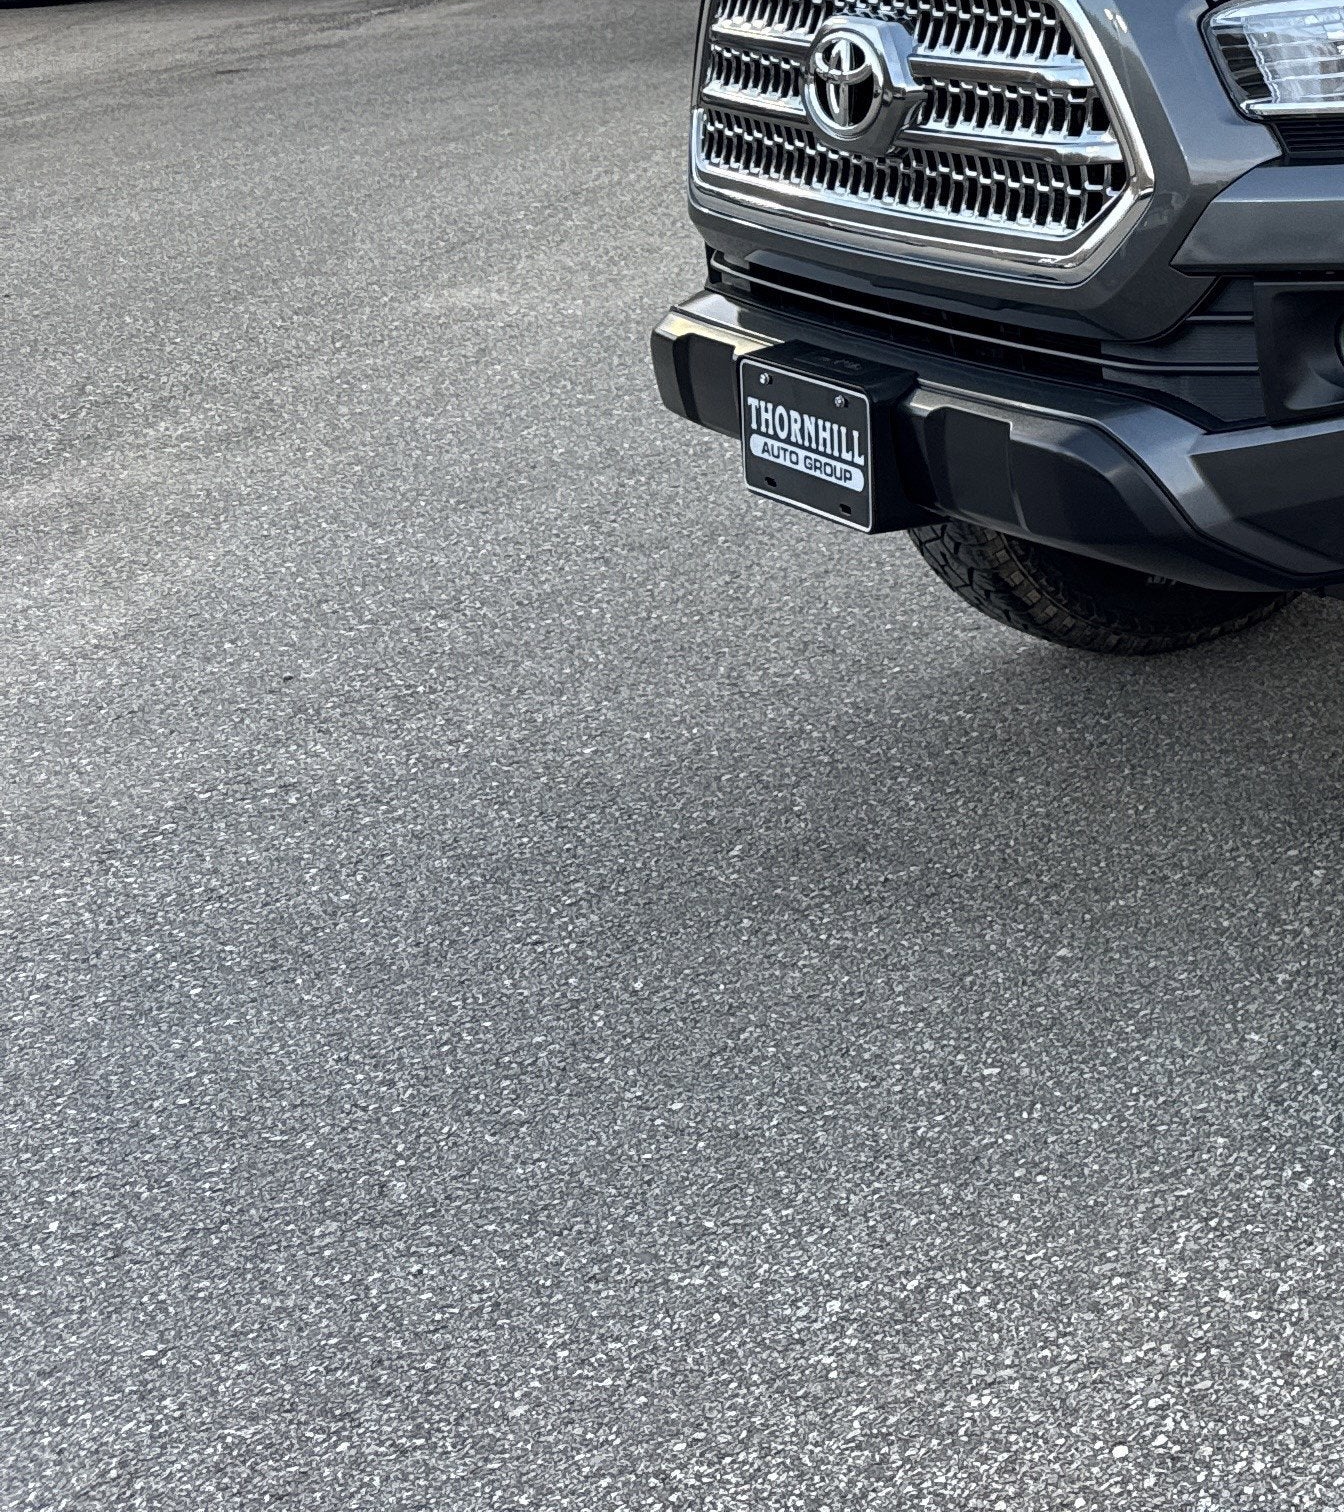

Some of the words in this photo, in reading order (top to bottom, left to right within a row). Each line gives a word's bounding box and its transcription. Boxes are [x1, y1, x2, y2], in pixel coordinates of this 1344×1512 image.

[747, 396, 865, 467] THORNHILL
[761, 441, 799, 466] AUTO
[803, 455, 853, 484] GROUP
